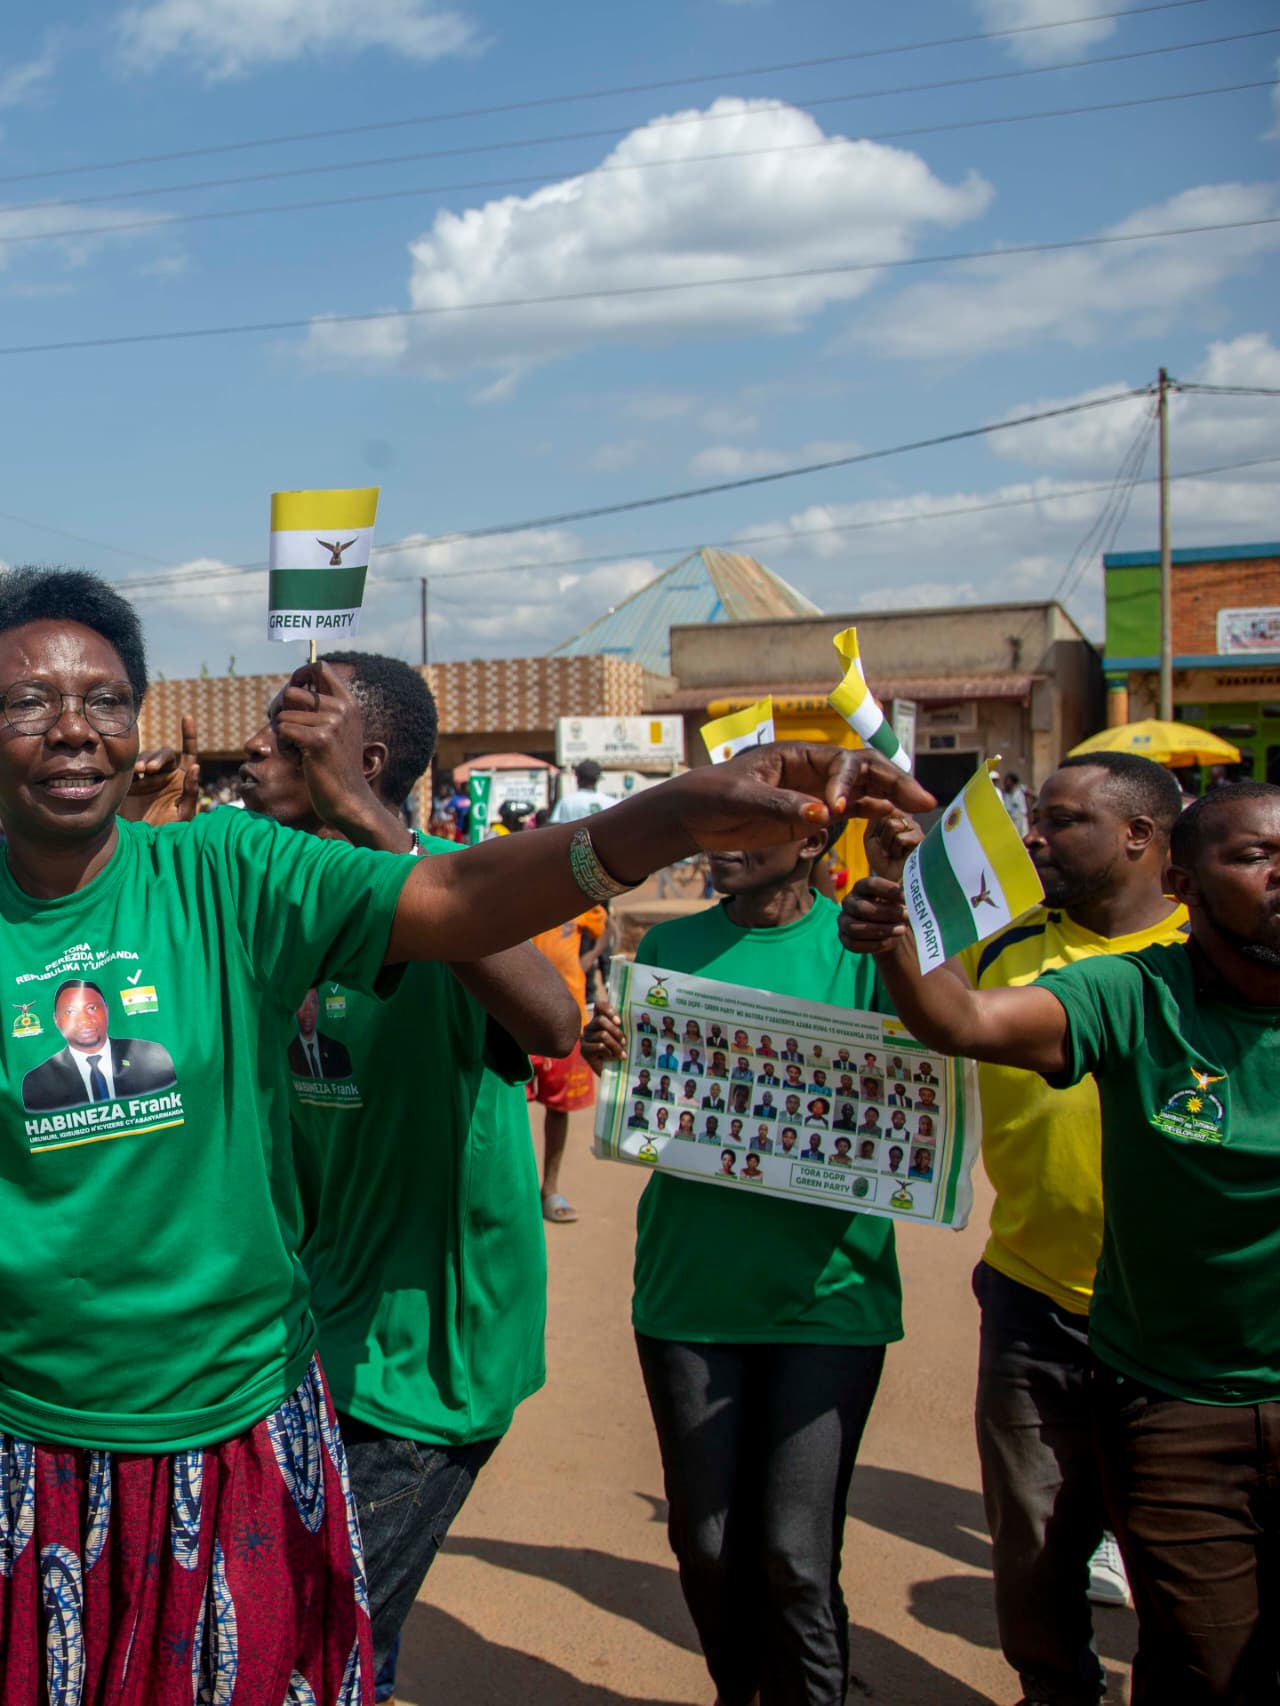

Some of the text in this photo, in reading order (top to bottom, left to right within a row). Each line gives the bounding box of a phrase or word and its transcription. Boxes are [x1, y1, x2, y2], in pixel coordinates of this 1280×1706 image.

[269, 613, 355, 628] GREEN PARTY
[910, 879, 928, 921] GREEN
[922, 920, 940, 960] PARTY
[63, 942, 91, 955] TORA
[45, 952, 94, 971] PEREZIDA
[16, 962, 80, 984] REPUBULIKA
[25, 1092, 183, 1136] HABINEZA Frank
[800, 1167, 845, 1181] TORA DGPR
[796, 1177, 850, 1192] GREEN PARTY
